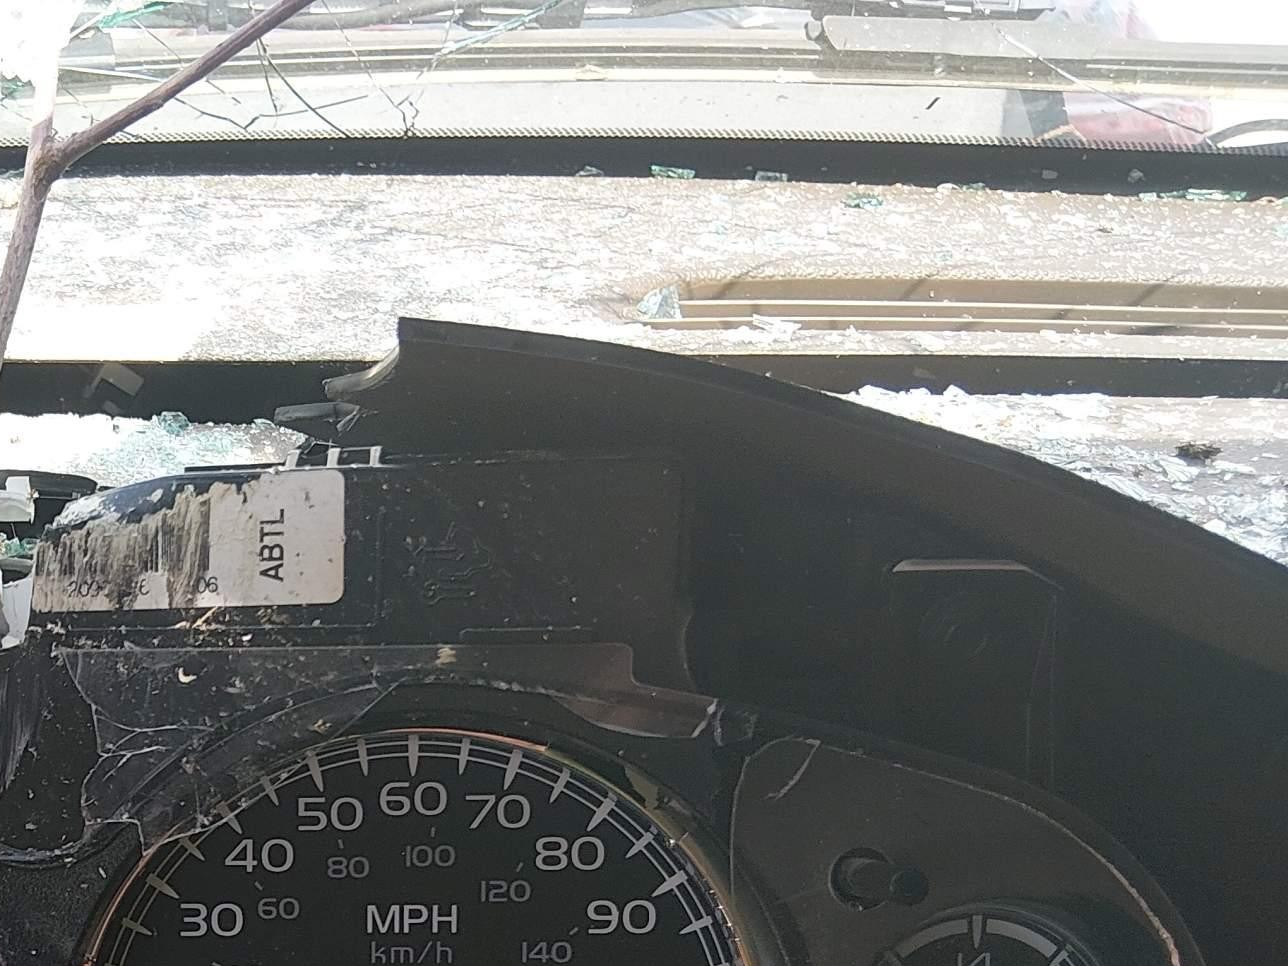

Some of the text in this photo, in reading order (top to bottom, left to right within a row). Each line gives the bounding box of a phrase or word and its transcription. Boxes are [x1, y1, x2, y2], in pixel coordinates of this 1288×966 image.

[259, 508, 285, 582] ABTL
[297, 797, 363, 831] 50
[379, 782, 447, 816] 60
[465, 794, 531, 829] 70
[224, 838, 295, 872] 40
[327, 857, 369, 879] 80
[405, 846, 455, 867] 100
[535, 836, 605, 871] 80
[480, 880, 531, 902] 120
[179, 903, 244, 937] 30
[257, 899, 300, 920] 60
[367, 905, 458, 934] MPH
[587, 900, 657, 935] 90
[370, 941, 453, 965] km/h
[521, 942, 573, 963] 140
